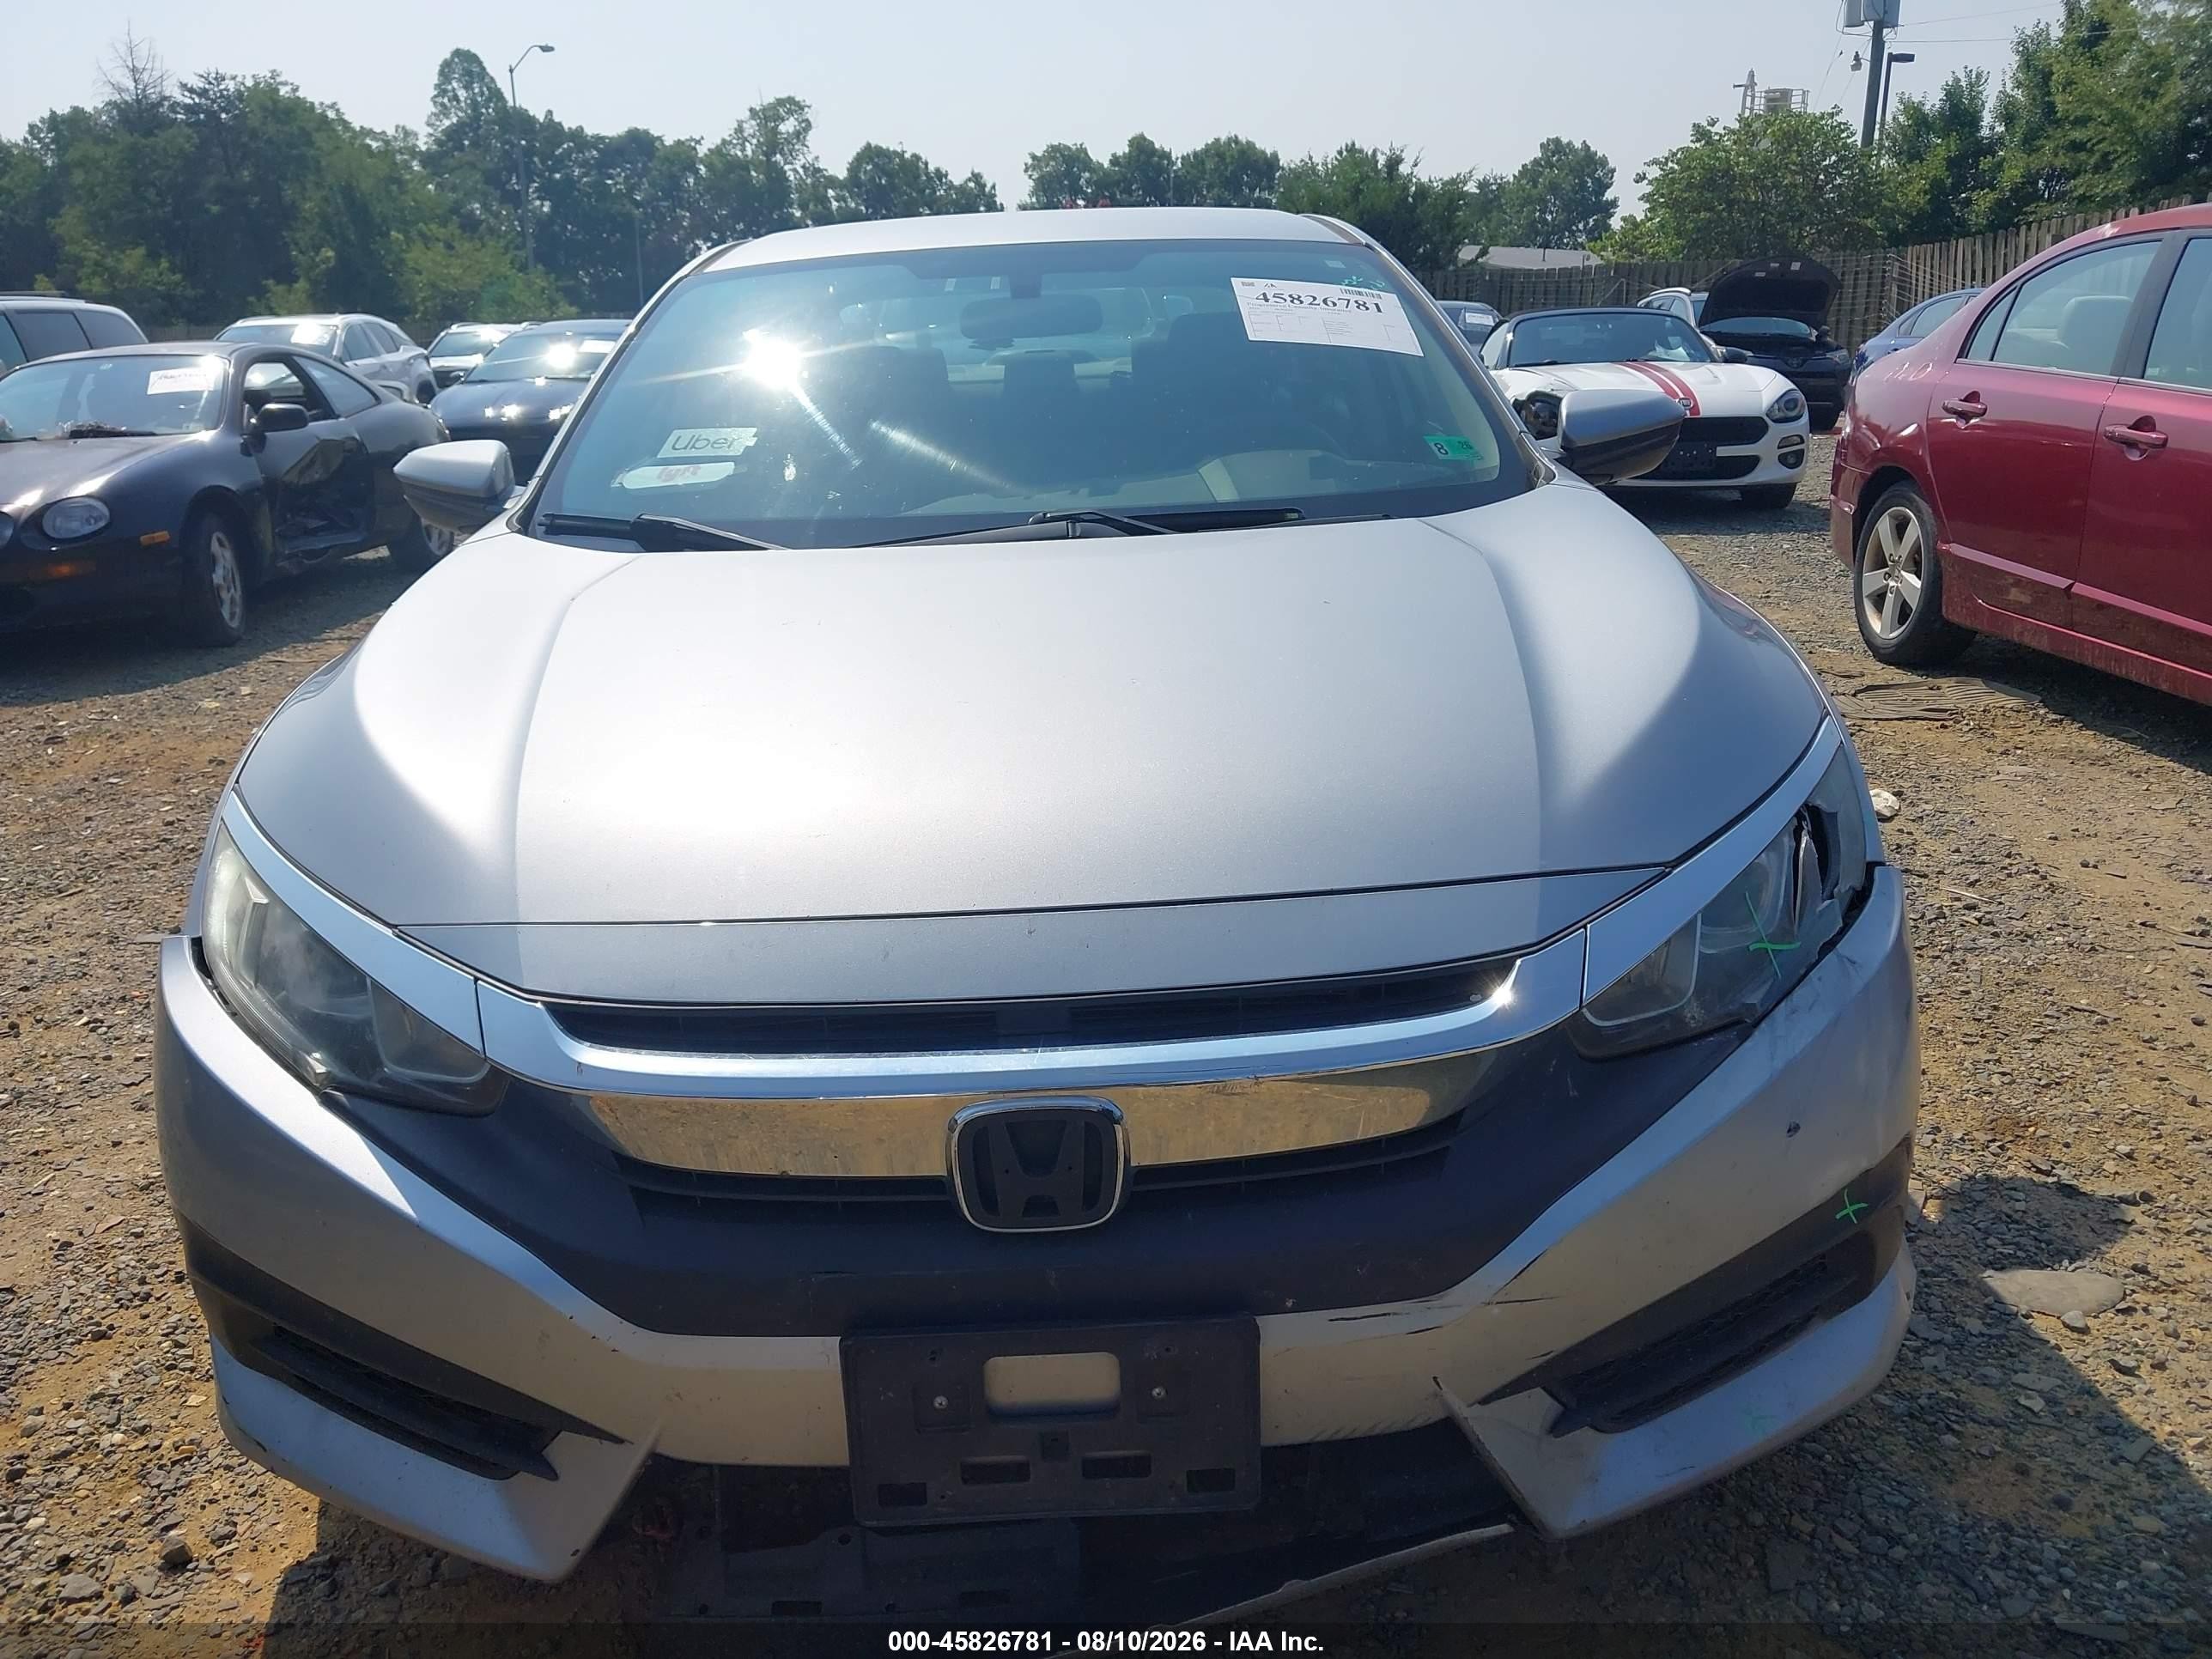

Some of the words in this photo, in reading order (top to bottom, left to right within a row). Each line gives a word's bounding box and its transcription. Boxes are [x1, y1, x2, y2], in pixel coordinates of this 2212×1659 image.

[1255, 291, 1385, 314] 45826781
[672, 434, 742, 451] Uber
[1434, 442, 1449, 455] 8
